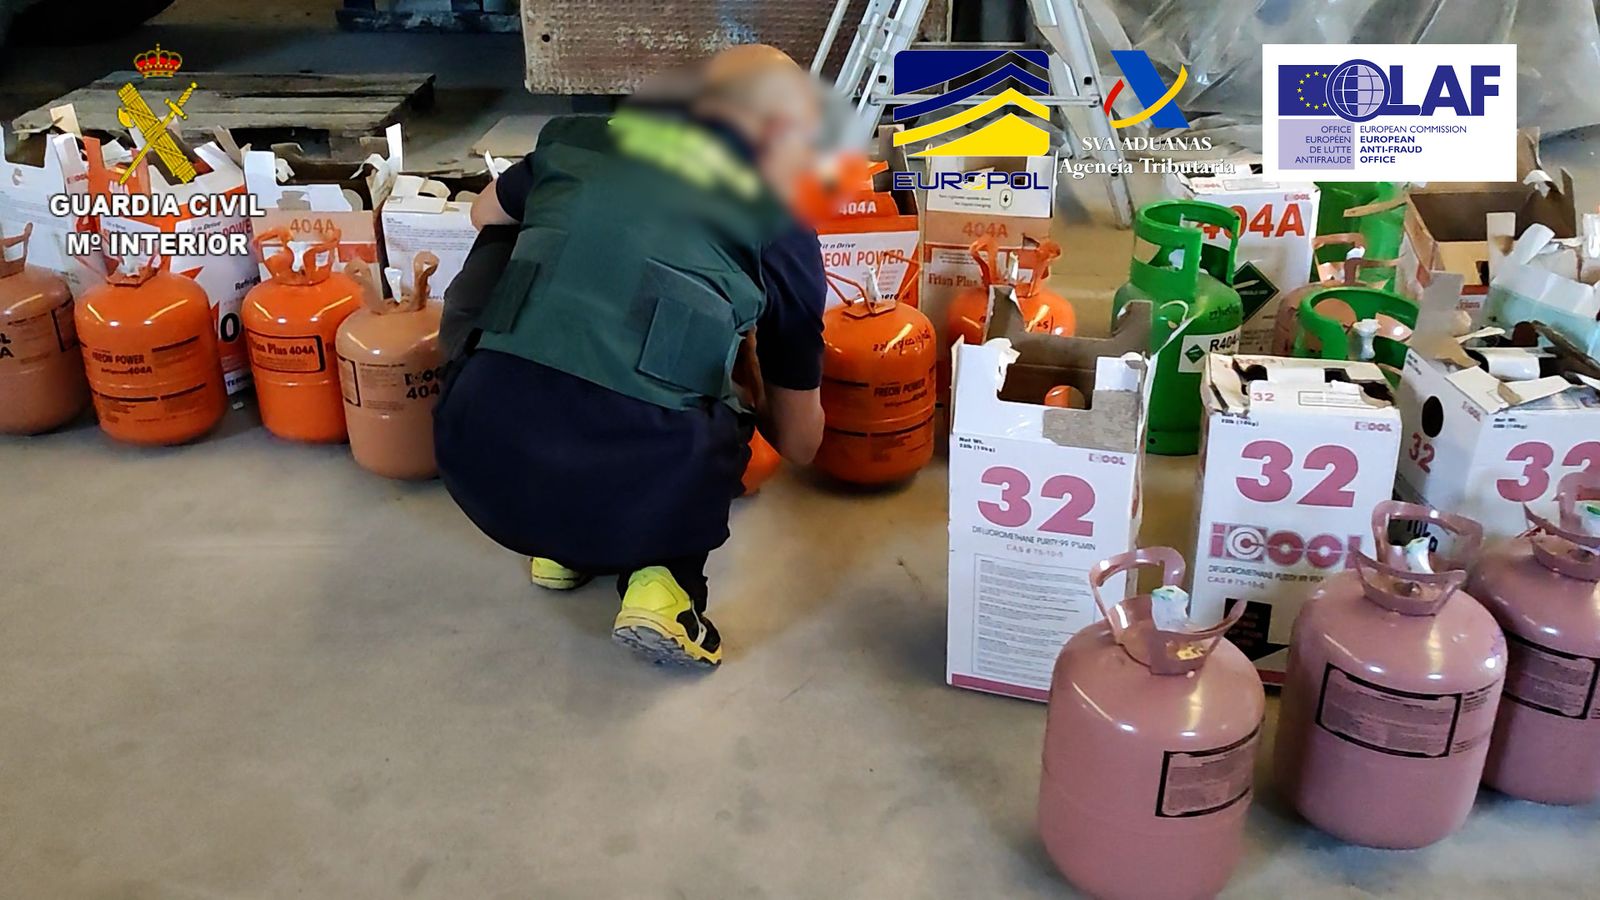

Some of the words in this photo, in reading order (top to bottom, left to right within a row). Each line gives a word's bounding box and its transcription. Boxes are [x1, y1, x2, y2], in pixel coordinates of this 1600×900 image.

[289, 218, 335, 234] 404A
[962, 221, 1008, 238] 404A
[824, 252, 851, 267] EON
[289, 345, 315, 356] 404A
[1254, 392, 1275, 402] 32
[1409, 432, 1435, 474] 32
[1236, 440, 1359, 507] 32
[1496, 441, 1600, 502] 32
[977, 466, 1096, 537] 32
